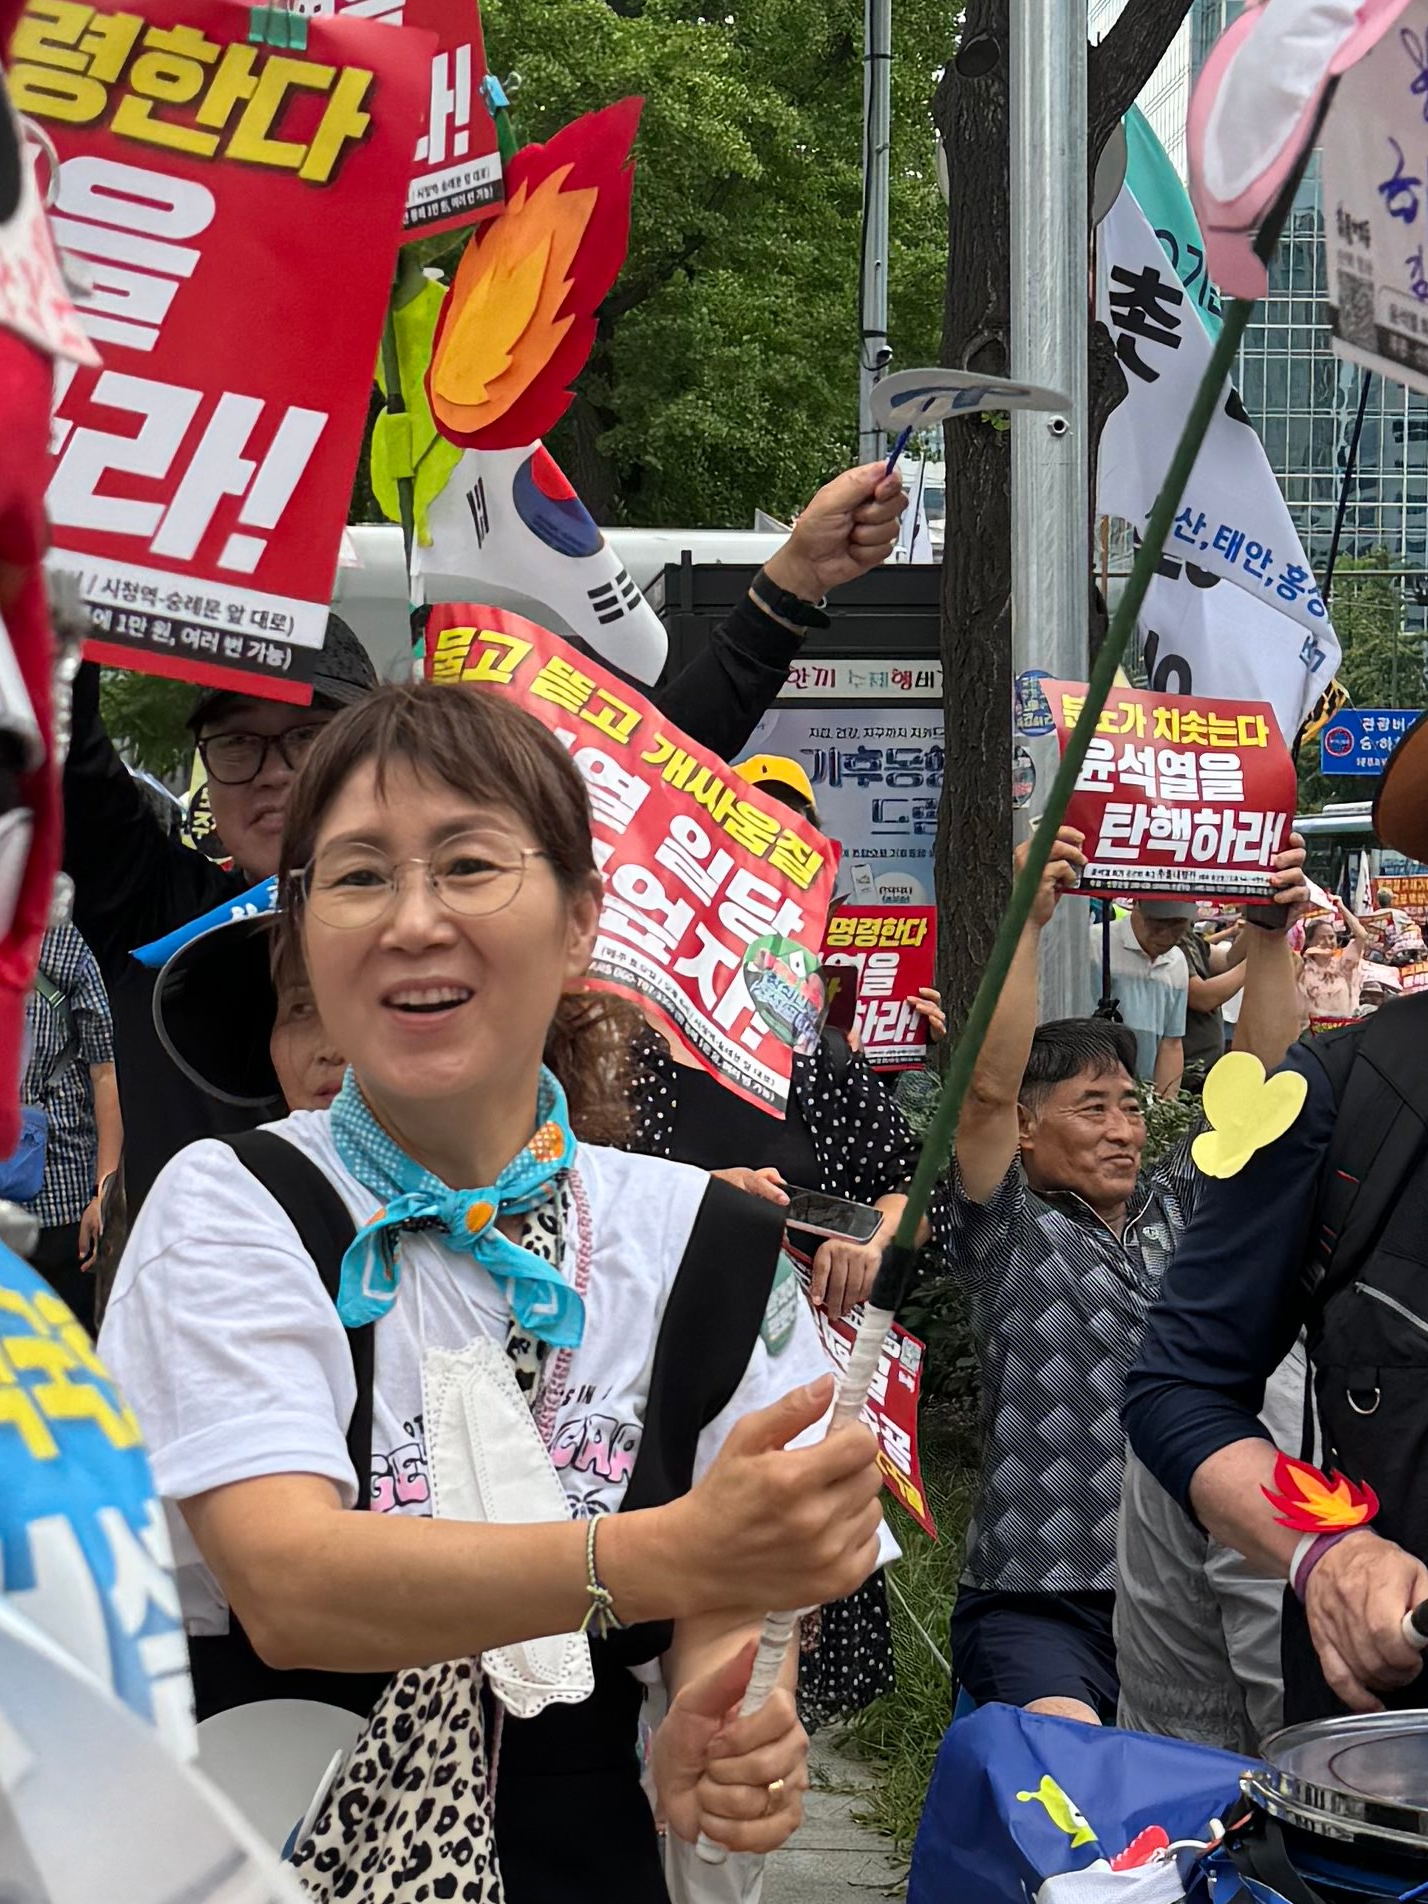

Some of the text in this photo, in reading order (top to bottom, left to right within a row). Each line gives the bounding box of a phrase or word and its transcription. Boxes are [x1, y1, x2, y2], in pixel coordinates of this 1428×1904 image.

[50, 361, 330, 574] 라!
[117, 612, 148, 639] 1만
[180, 627, 220, 655] 여러
[223, 634, 245, 659] 번
[246, 641, 294, 672] 가능)
[227, 603, 247, 626] 앞
[249, 608, 296, 639] 대로)
[432, 627, 534, 686] 물고
[641, 731, 825, 891] 개싸움질
[1152, 705, 1271, 748] 치솟는다
[1073, 737, 1245, 802] 윤석열을
[553, 726, 806, 948] 열 일당
[1093, 801, 1287, 866] 탄핵하라!
[591, 836, 772, 1052] 엎자!
[826, 917, 928, 947] 명령한다
